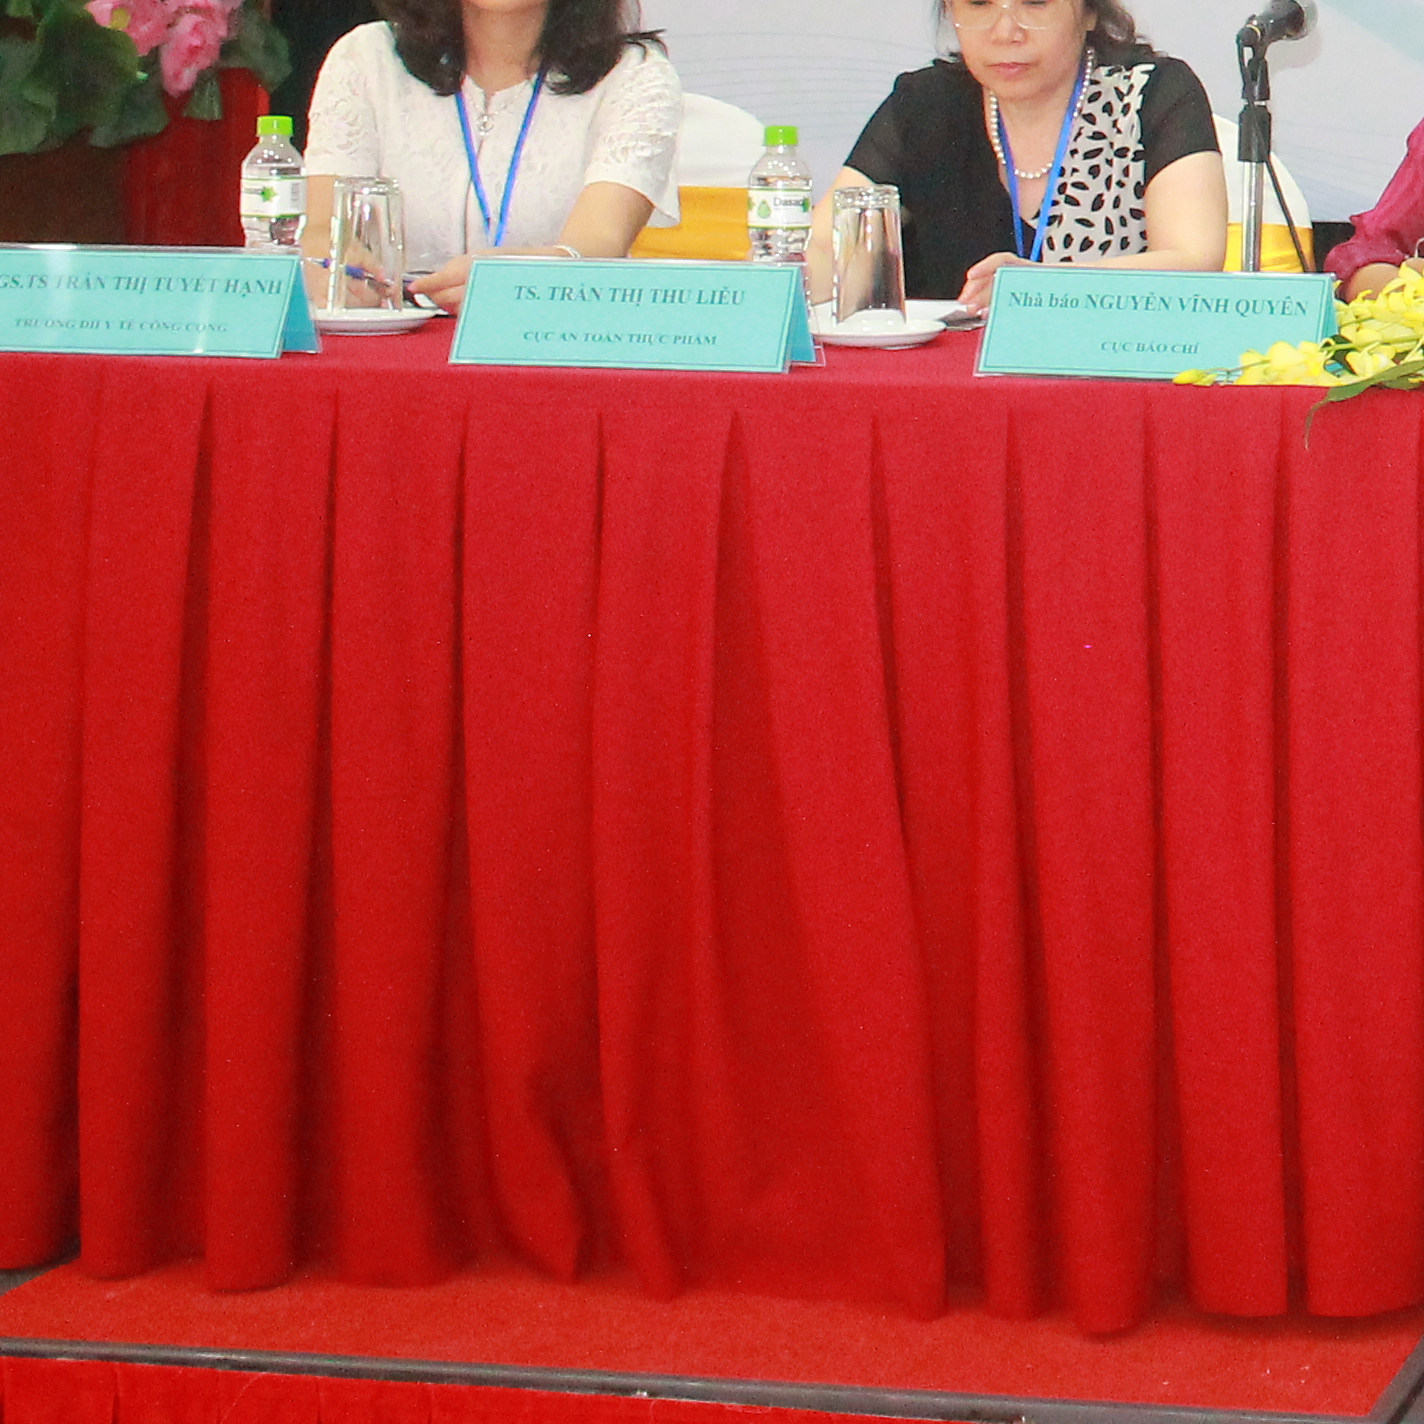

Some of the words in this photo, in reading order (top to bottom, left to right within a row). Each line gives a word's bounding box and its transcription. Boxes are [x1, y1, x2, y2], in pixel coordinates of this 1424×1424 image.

[223, 278, 284, 298] HẠNH
[514, 285, 541, 300] TS.
[608, 287, 645, 307] THỊ
[650, 288, 692, 304] THU
[1008, 291, 1044, 308] Nhà
[1048, 292, 1080, 309] báo
[1234, 295, 1309, 318] QUYÊN
[559, 333, 578, 342] AN
[1100, 340, 1132, 353] CỤC
[1135, 340, 1168, 354] BÁO
[1171, 340, 1200, 354] CHÍ
